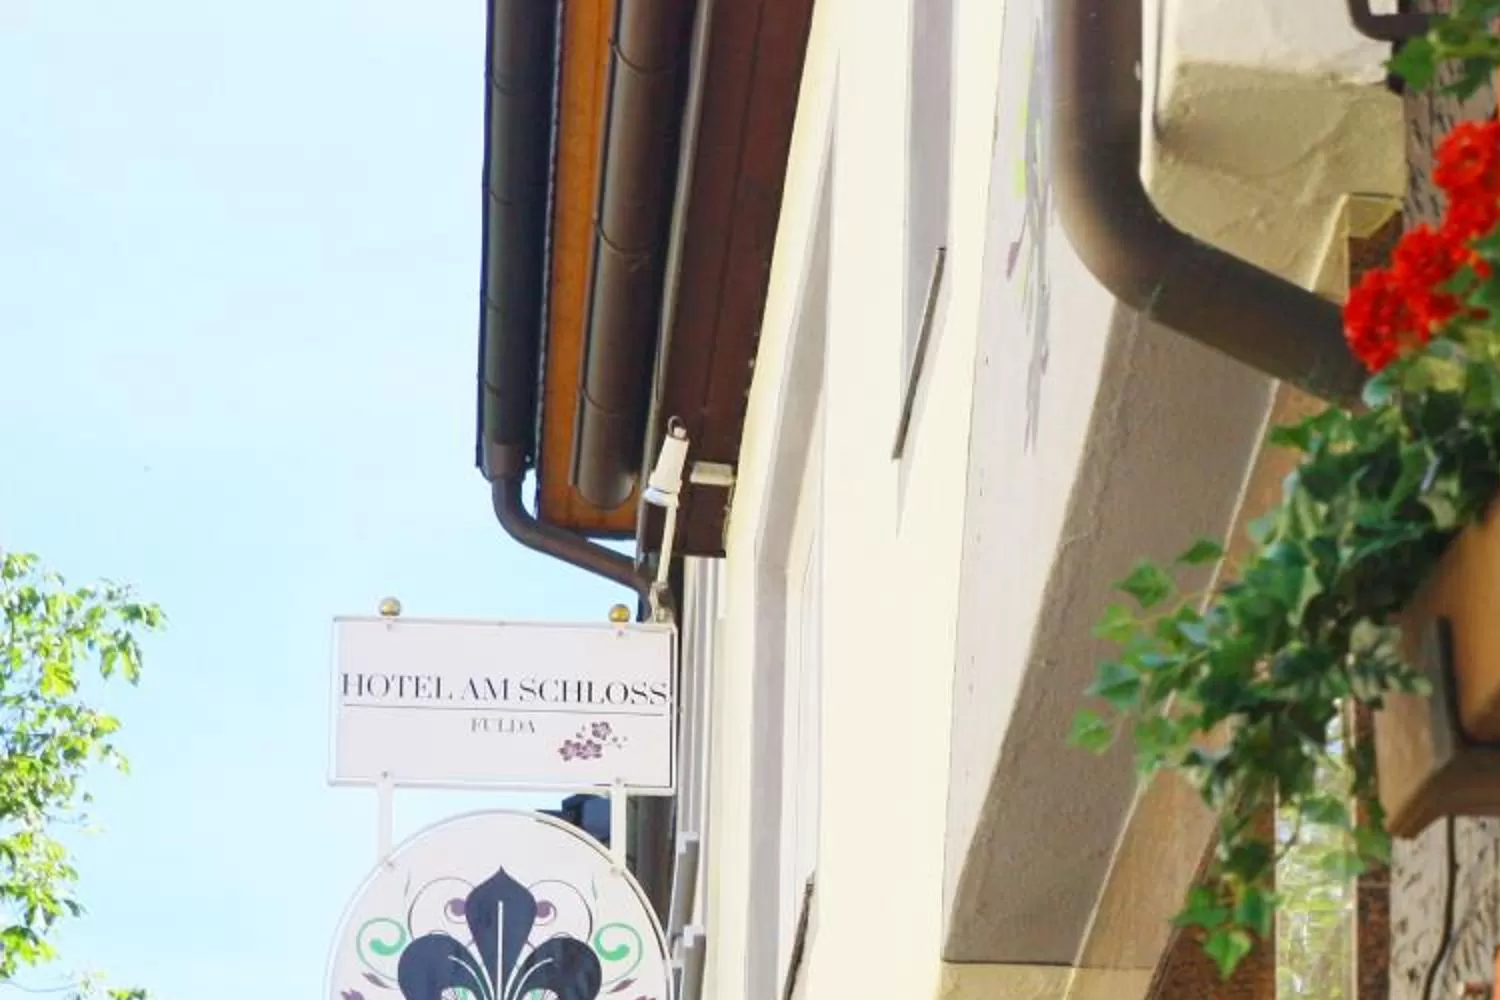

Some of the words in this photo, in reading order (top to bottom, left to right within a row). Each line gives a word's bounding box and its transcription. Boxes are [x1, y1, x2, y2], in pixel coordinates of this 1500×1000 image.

[342, 673, 453, 700] HOTEL
[461, 677, 509, 702] AM
[518, 678, 668, 706] SCHLOSS
[470, 717, 536, 734] FULDA
